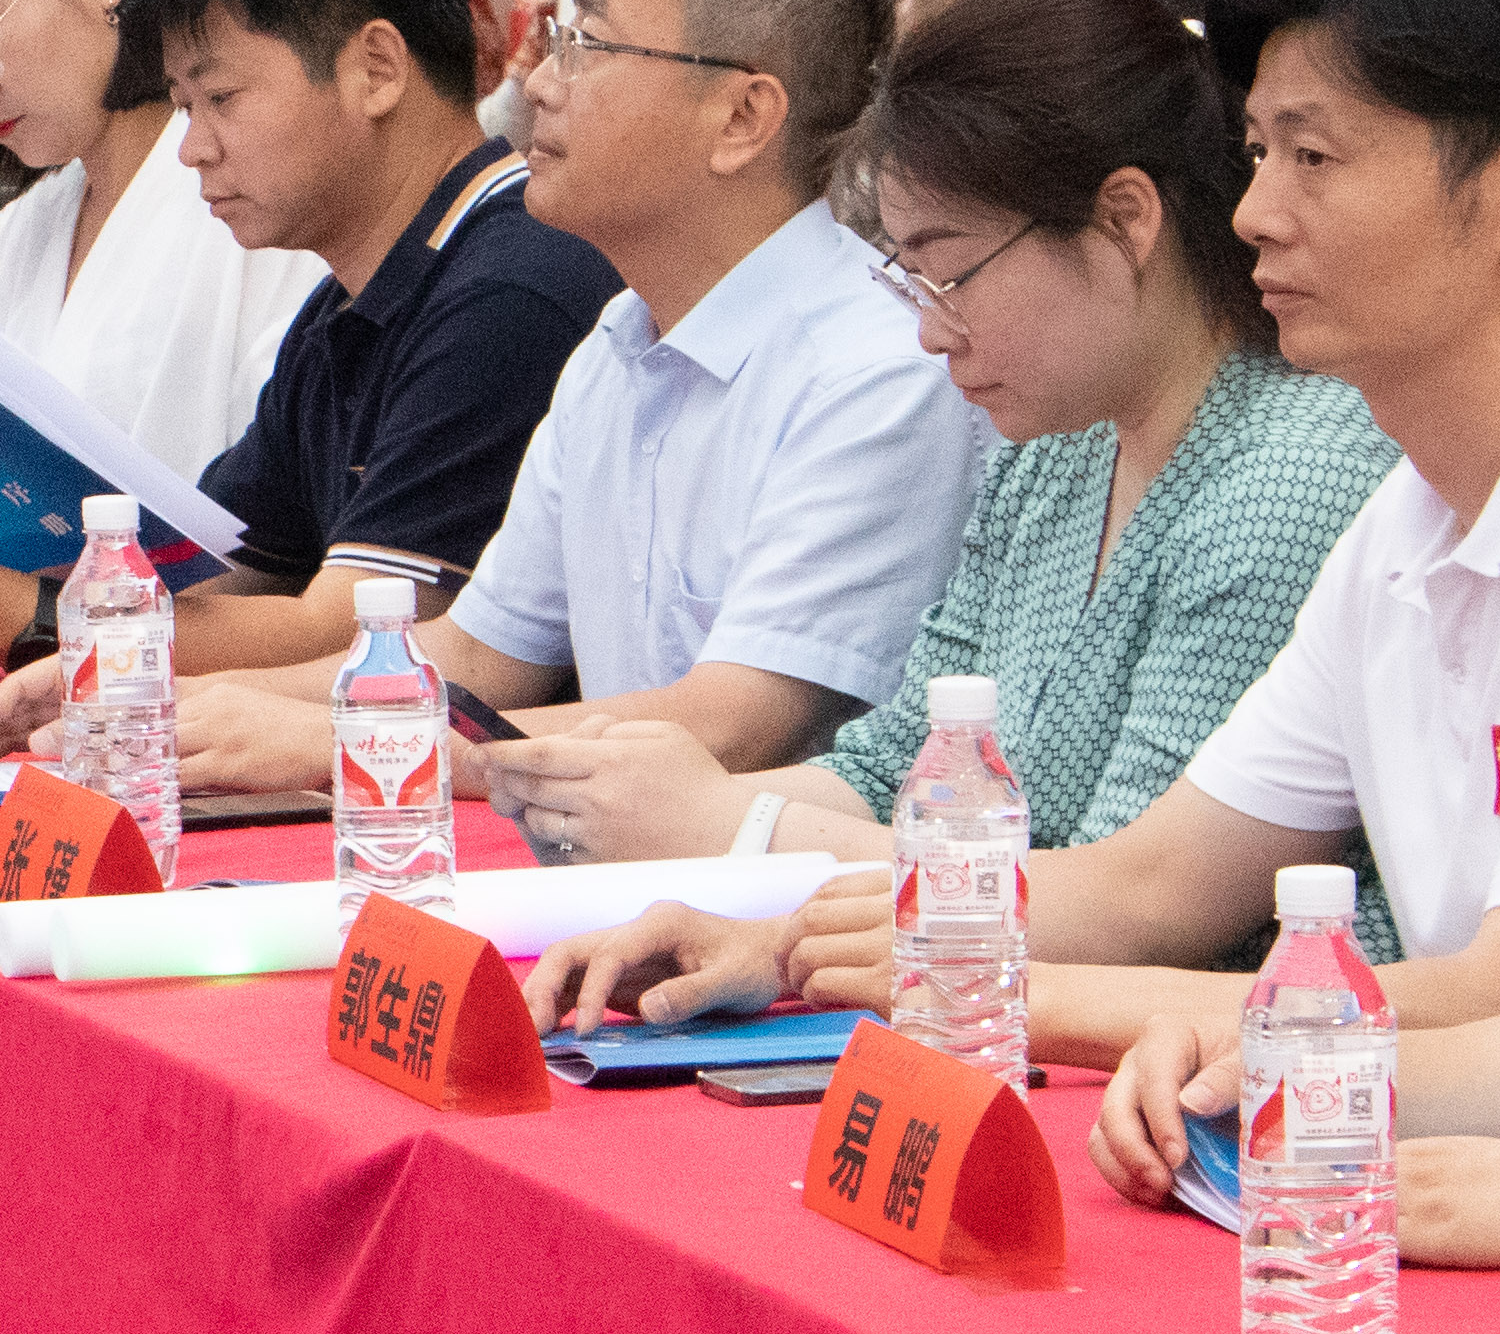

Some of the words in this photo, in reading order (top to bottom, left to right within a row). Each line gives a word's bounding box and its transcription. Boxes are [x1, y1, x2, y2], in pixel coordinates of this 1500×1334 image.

[355, 734, 423, 755] 娃哈哈
[338, 947, 446, 1081] 郭生鼎
[828, 1090, 940, 1230] 易鹏
